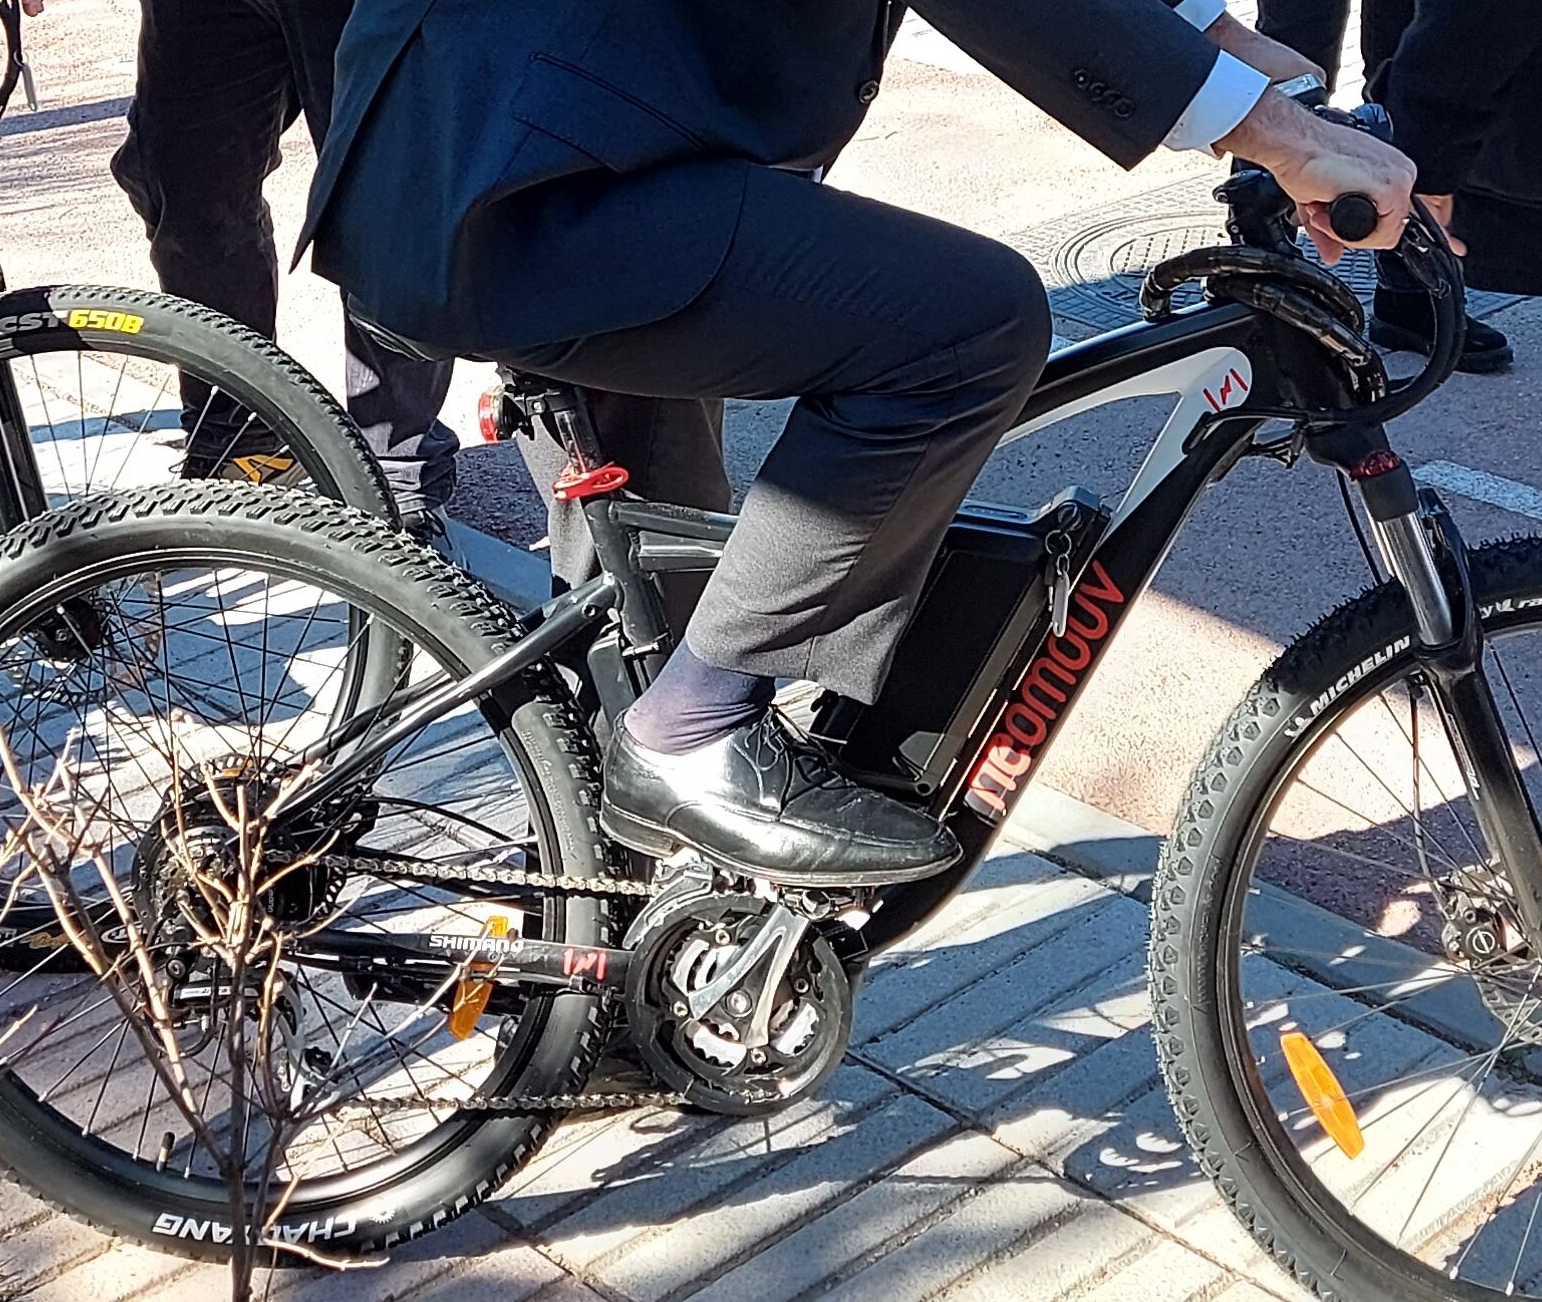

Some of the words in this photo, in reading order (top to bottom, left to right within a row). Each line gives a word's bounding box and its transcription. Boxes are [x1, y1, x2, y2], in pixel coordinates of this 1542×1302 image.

[68, 309, 145, 335] 650B
[1309, 634, 1411, 717] MICHELIN
[428, 934, 524, 953] SHIMANO
